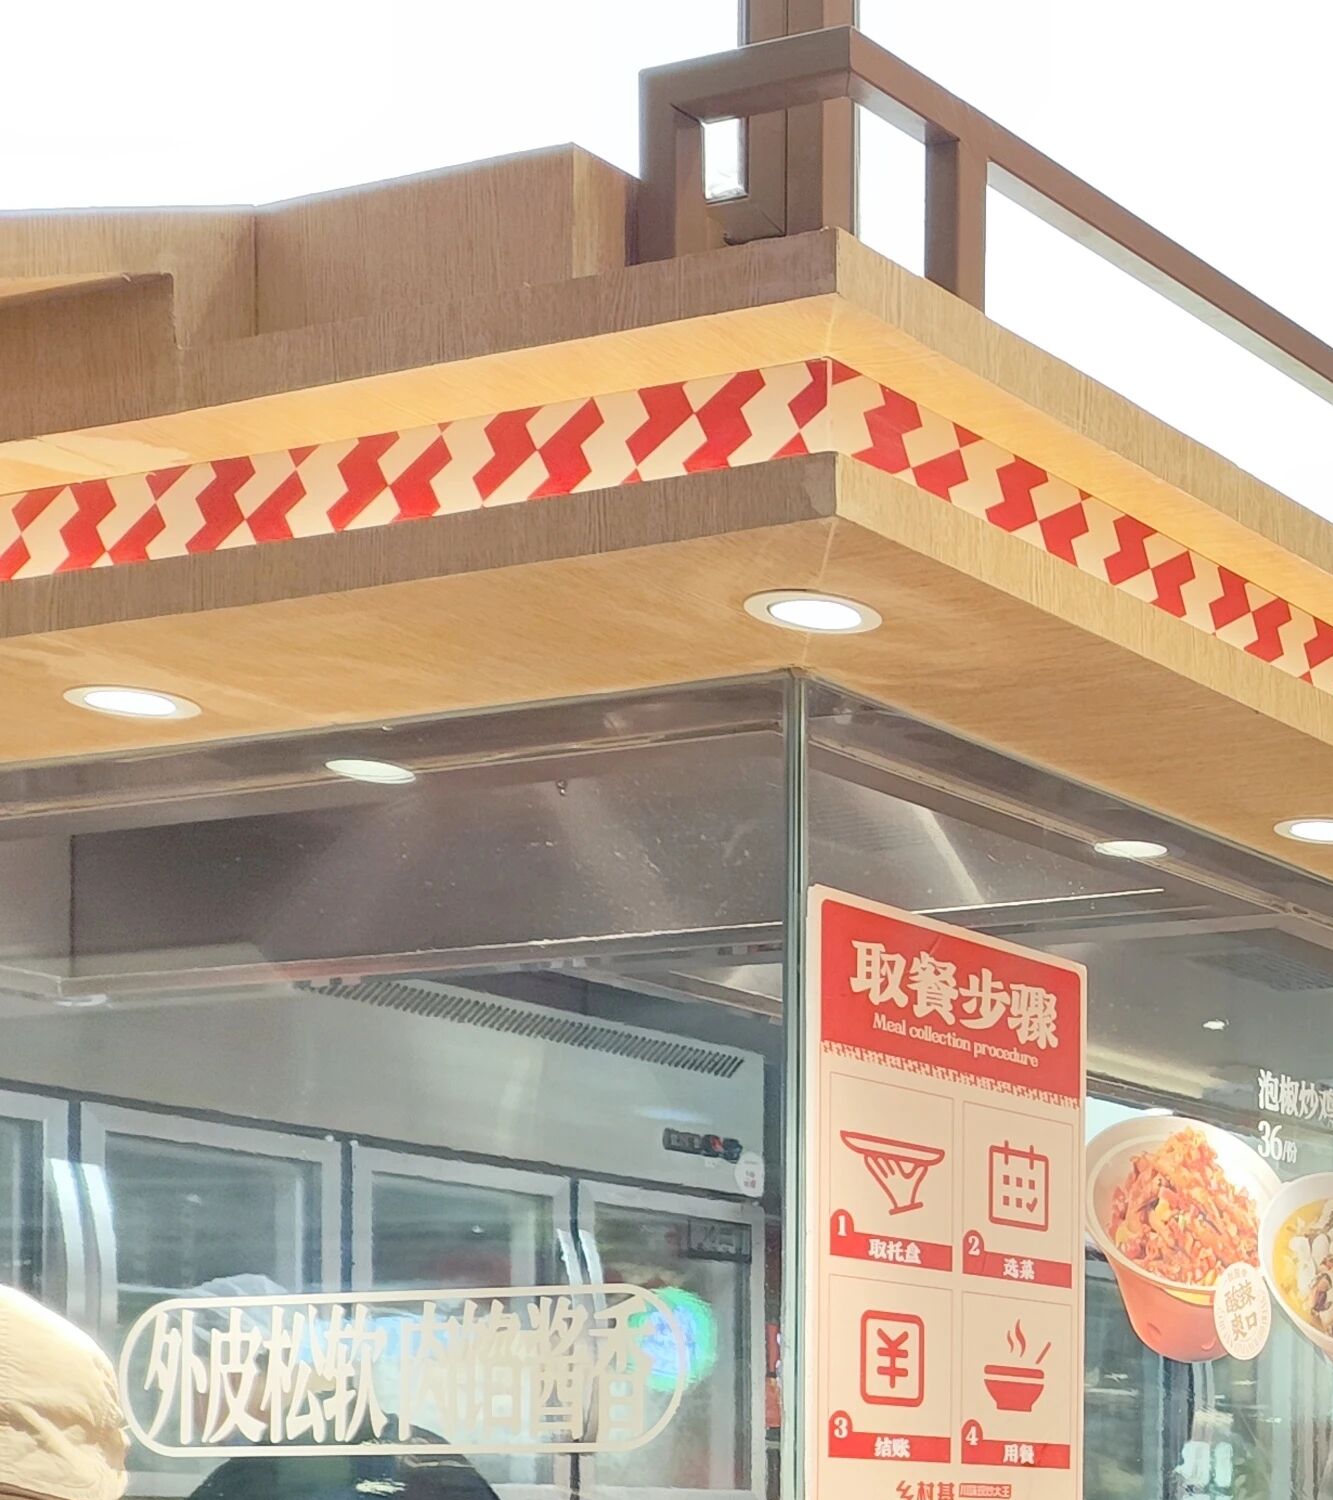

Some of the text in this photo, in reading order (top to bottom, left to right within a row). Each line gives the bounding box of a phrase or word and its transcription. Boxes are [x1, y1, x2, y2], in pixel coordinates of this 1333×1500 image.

[850, 939, 1059, 1050] 取餐步骤
[873, 1012, 1038, 1067] Meal collection procedure
[1257, 1120, 1298, 1164] 36/份
[837, 1215, 847, 1236] 1
[868, 1238, 922, 1265] 取托盘
[968, 1235, 981, 1256] 2
[1002, 1257, 1036, 1280] 选菜
[1224, 1279, 1256, 1313] 酸辣
[1231, 1311, 1258, 1341] 爽口
[834, 1416, 849, 1438] 3
[965, 1426, 978, 1446] 4
[874, 1437, 911, 1459] 结账
[1002, 1444, 1035, 1465] 用餐
